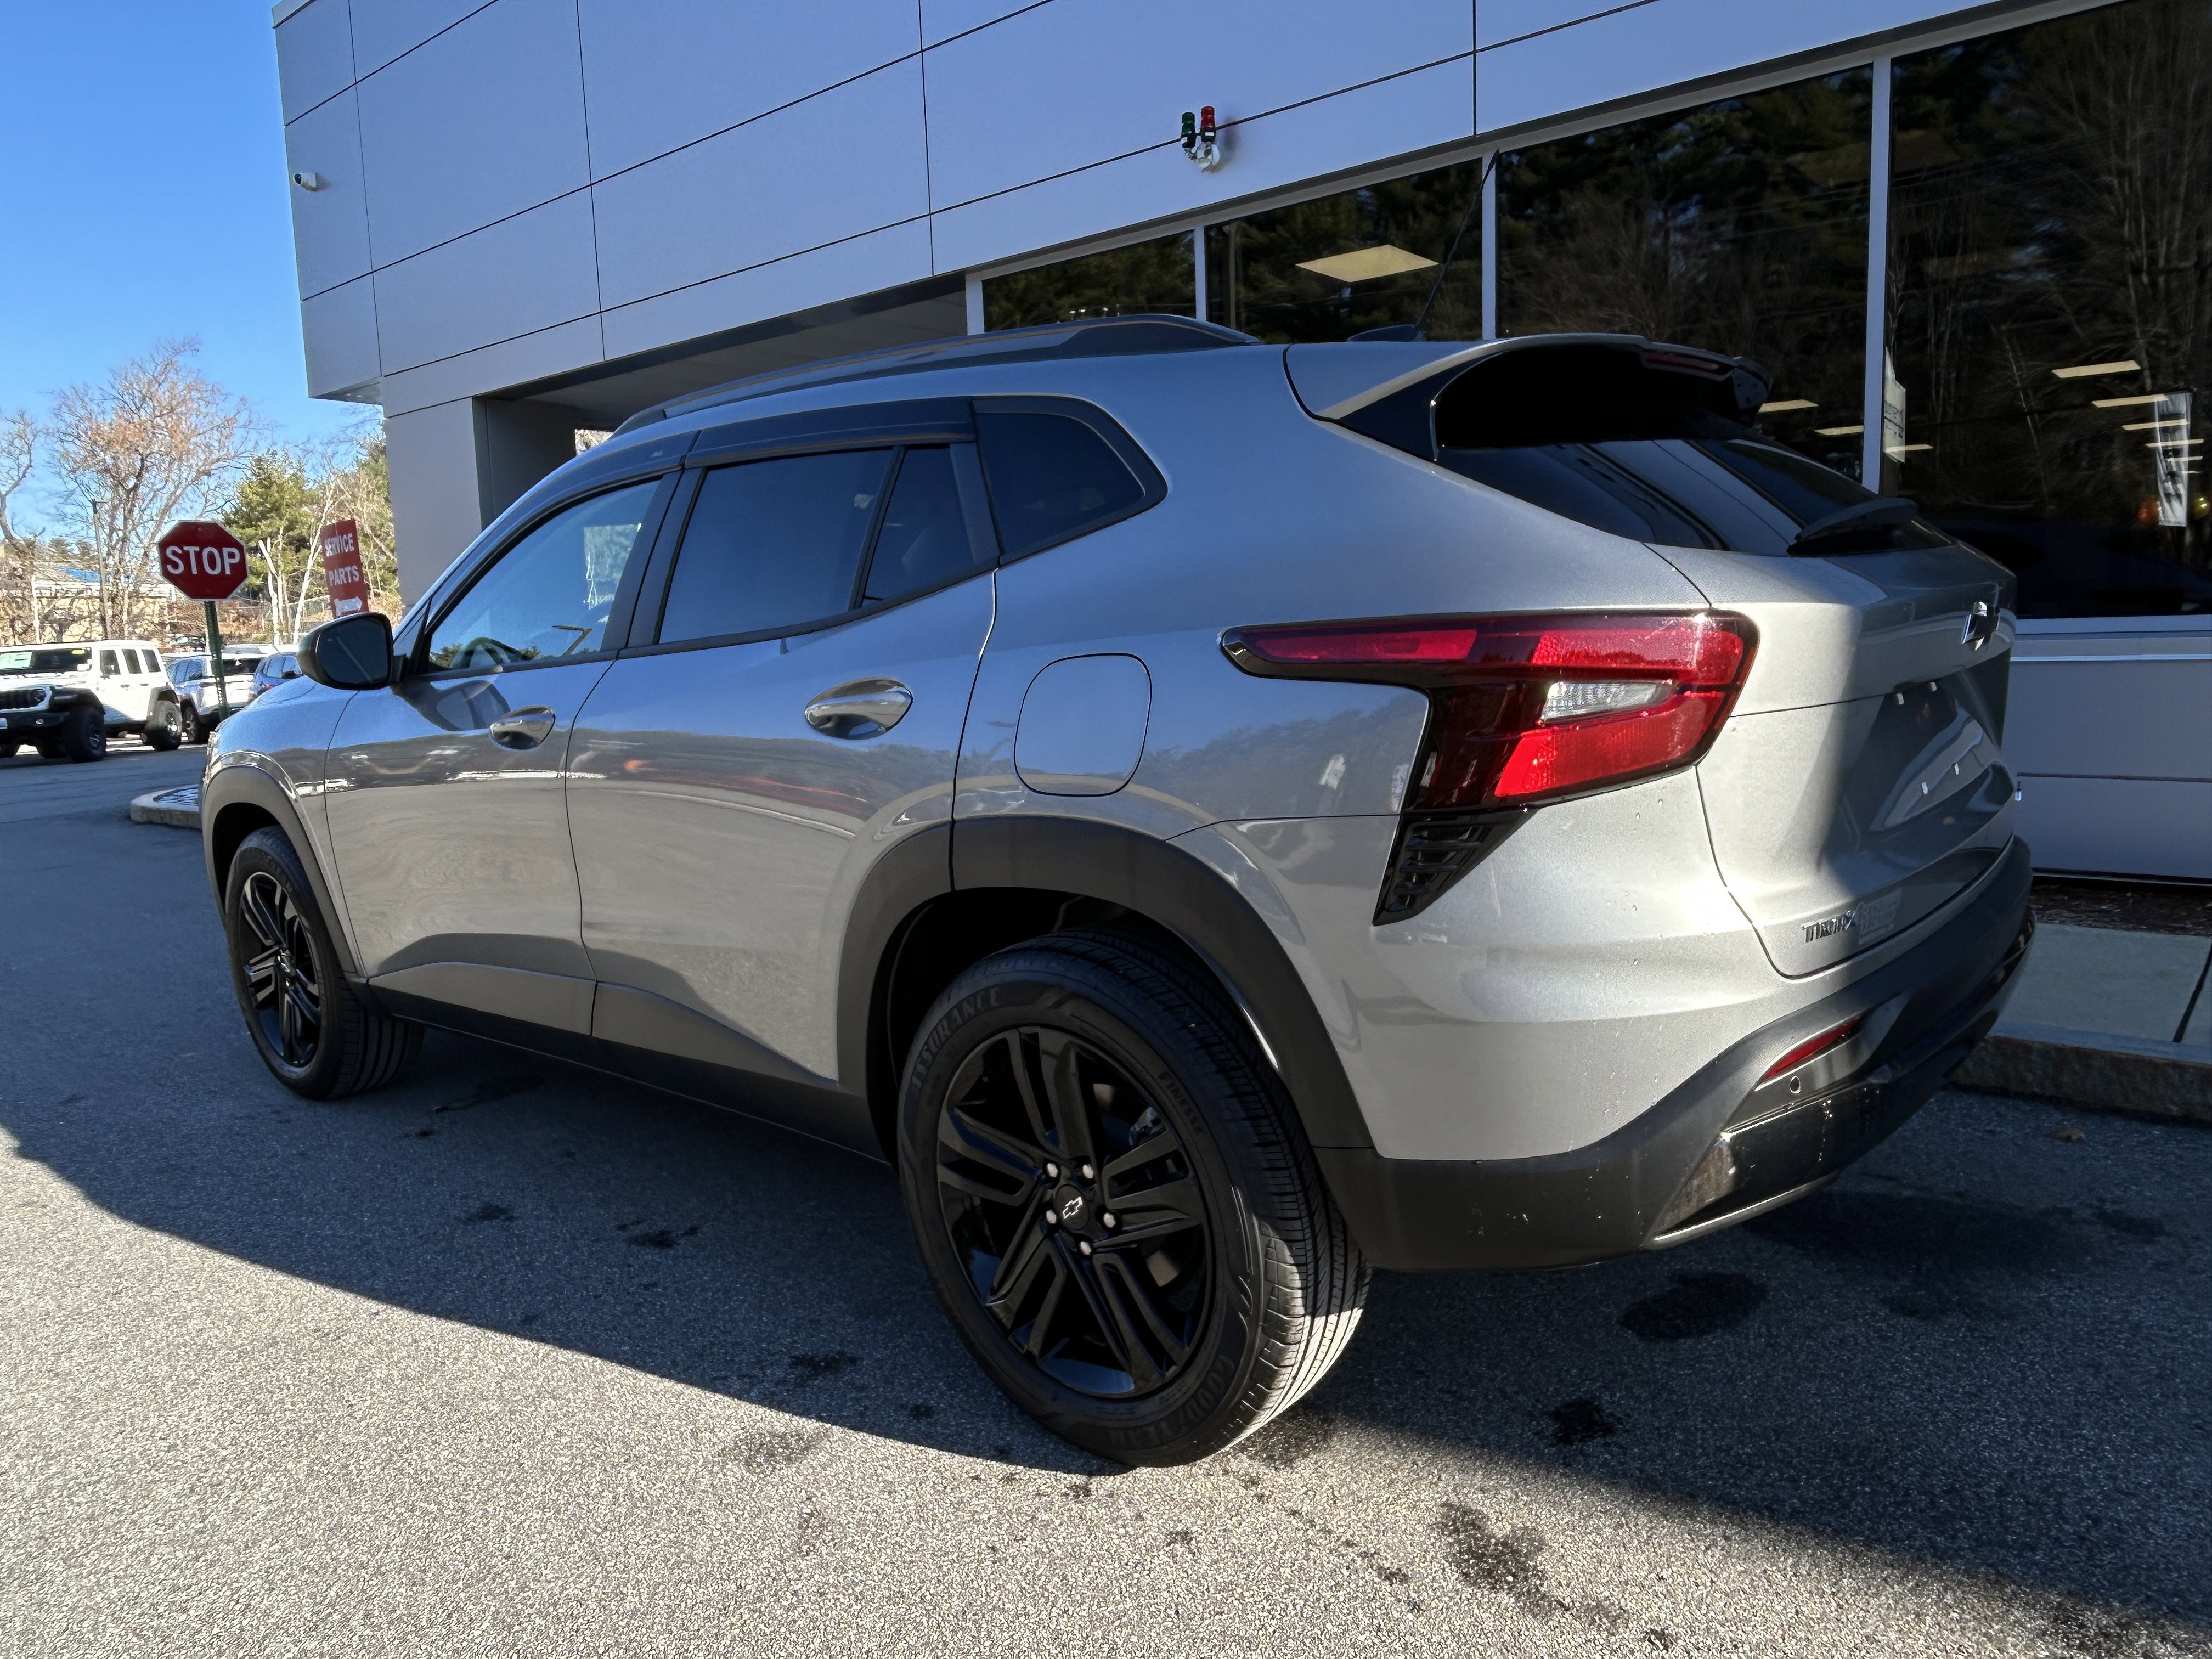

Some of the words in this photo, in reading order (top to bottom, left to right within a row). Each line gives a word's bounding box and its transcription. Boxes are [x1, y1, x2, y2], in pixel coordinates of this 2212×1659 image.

[324, 533, 354, 557] SERVICE
[166, 545, 241, 575] STOP
[329, 566, 360, 586] PARTS
